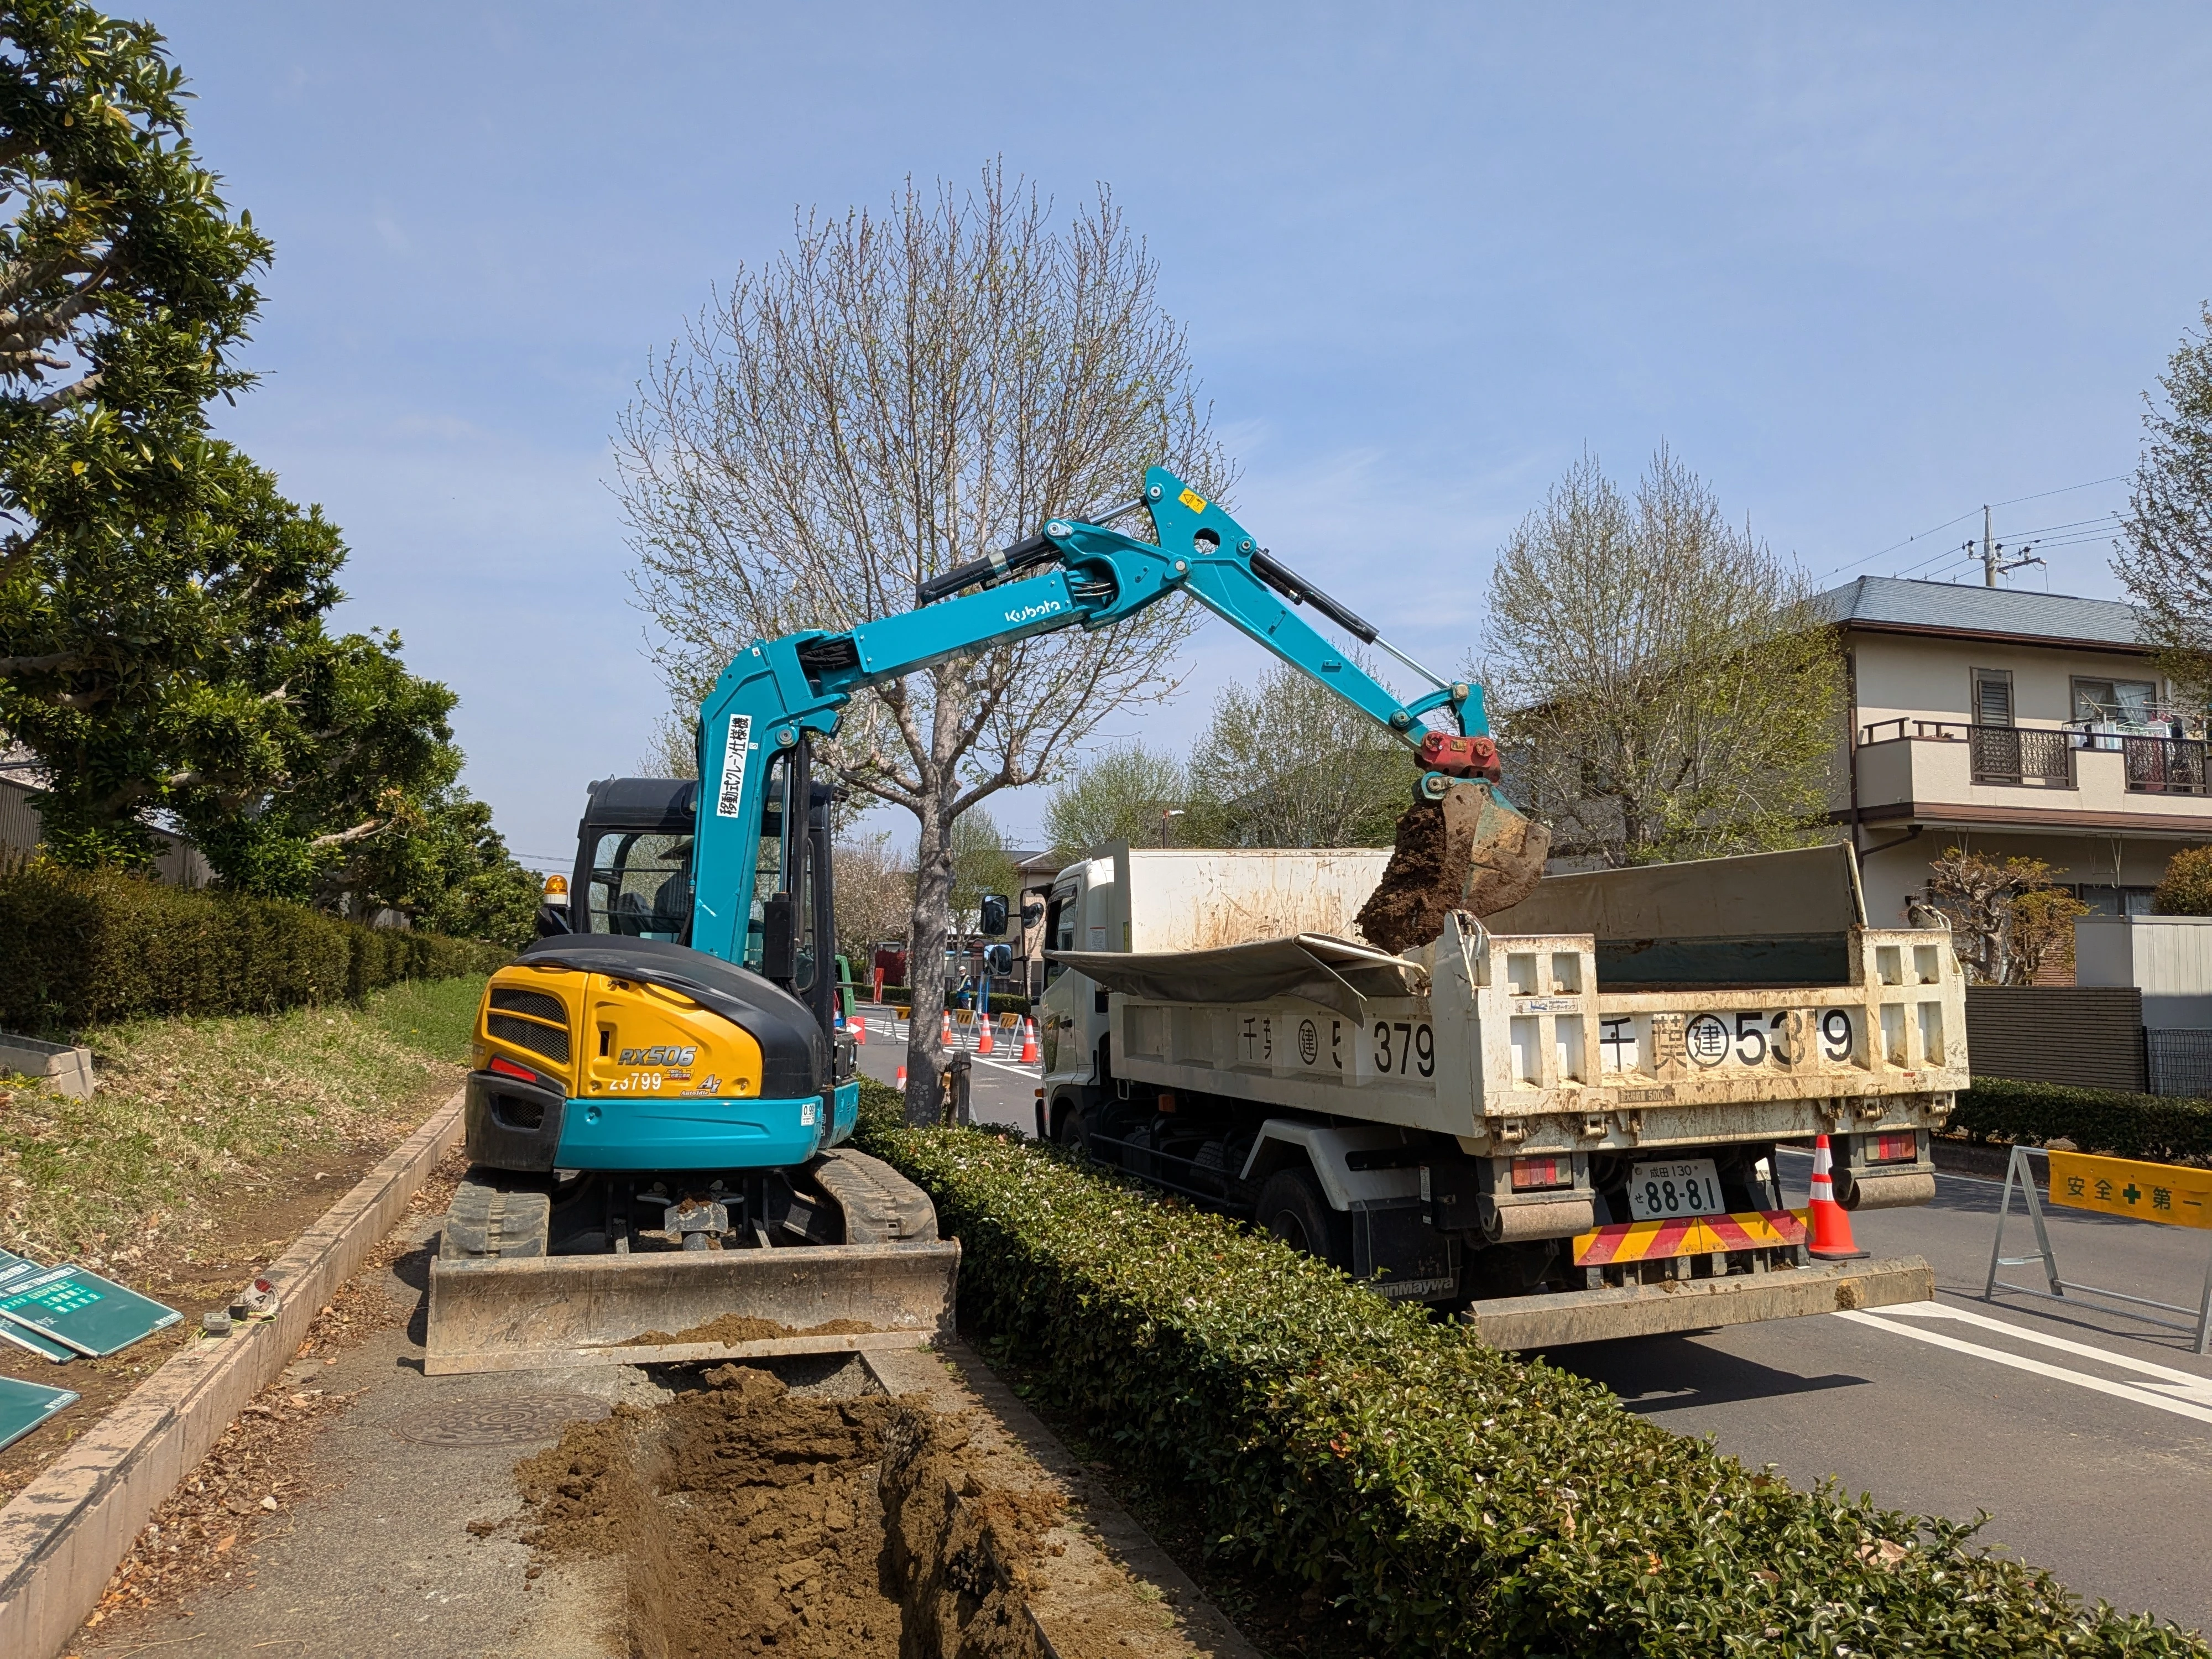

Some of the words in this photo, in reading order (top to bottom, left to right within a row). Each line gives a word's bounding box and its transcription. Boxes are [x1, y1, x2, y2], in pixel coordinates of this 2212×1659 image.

[1005, 600, 1061, 622] Kubota
[719, 717, 749, 815] 移動式クレーン仕様機
[618, 1046, 698, 1066] RX506
[1650, 1167, 1669, 1178] 成田
[1672, 1165, 1692, 1176] 130
[1635, 1193, 1644, 1204] せ
[1645, 1178, 1715, 1213] 88-81
[2068, 1176, 2112, 1201] 安全
[2152, 1187, 2201, 1210] 第一
